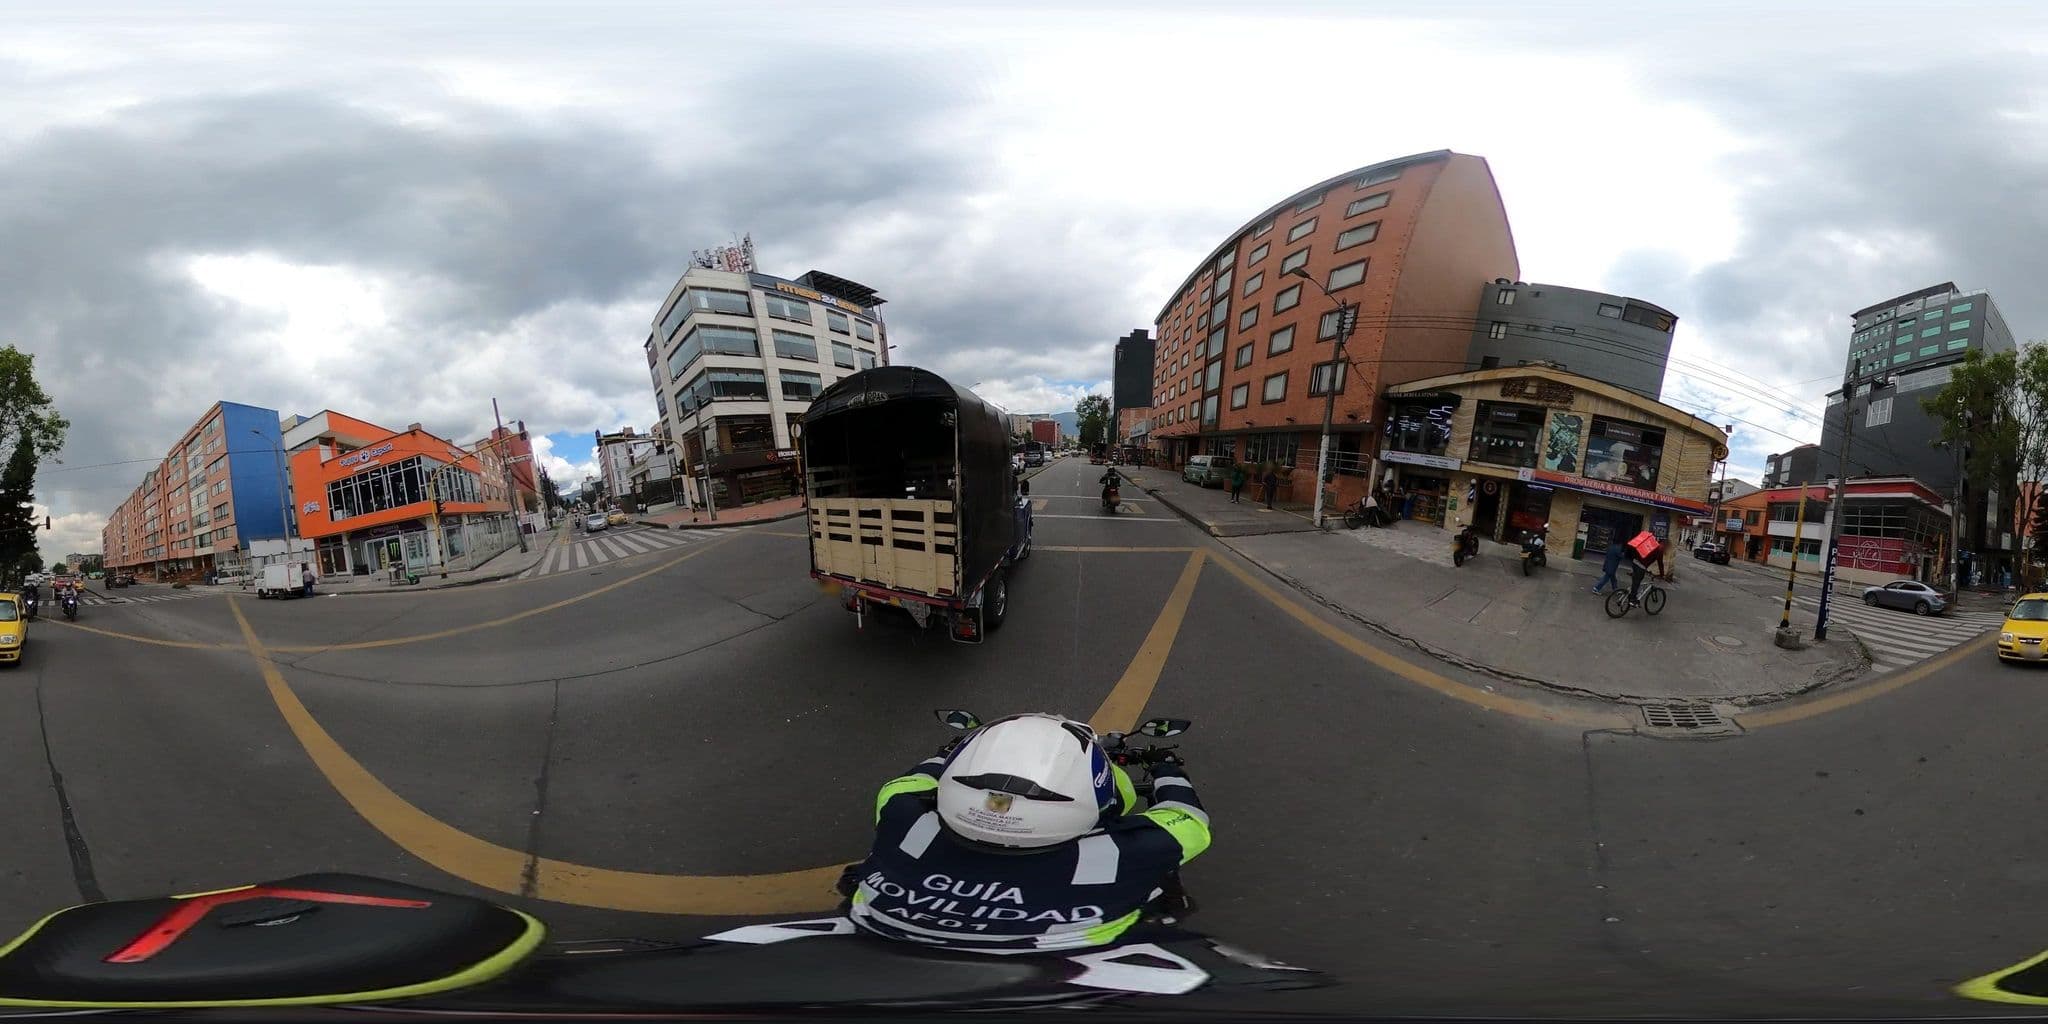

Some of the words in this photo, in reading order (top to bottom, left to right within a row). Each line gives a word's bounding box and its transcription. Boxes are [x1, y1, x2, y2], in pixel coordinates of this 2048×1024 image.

[1660, 495, 1675, 504] WIN
[866, 871, 1104, 922] MOVILIDAD
[922, 874, 1024, 904] GUÍA
[887, 907, 988, 931] AF01
